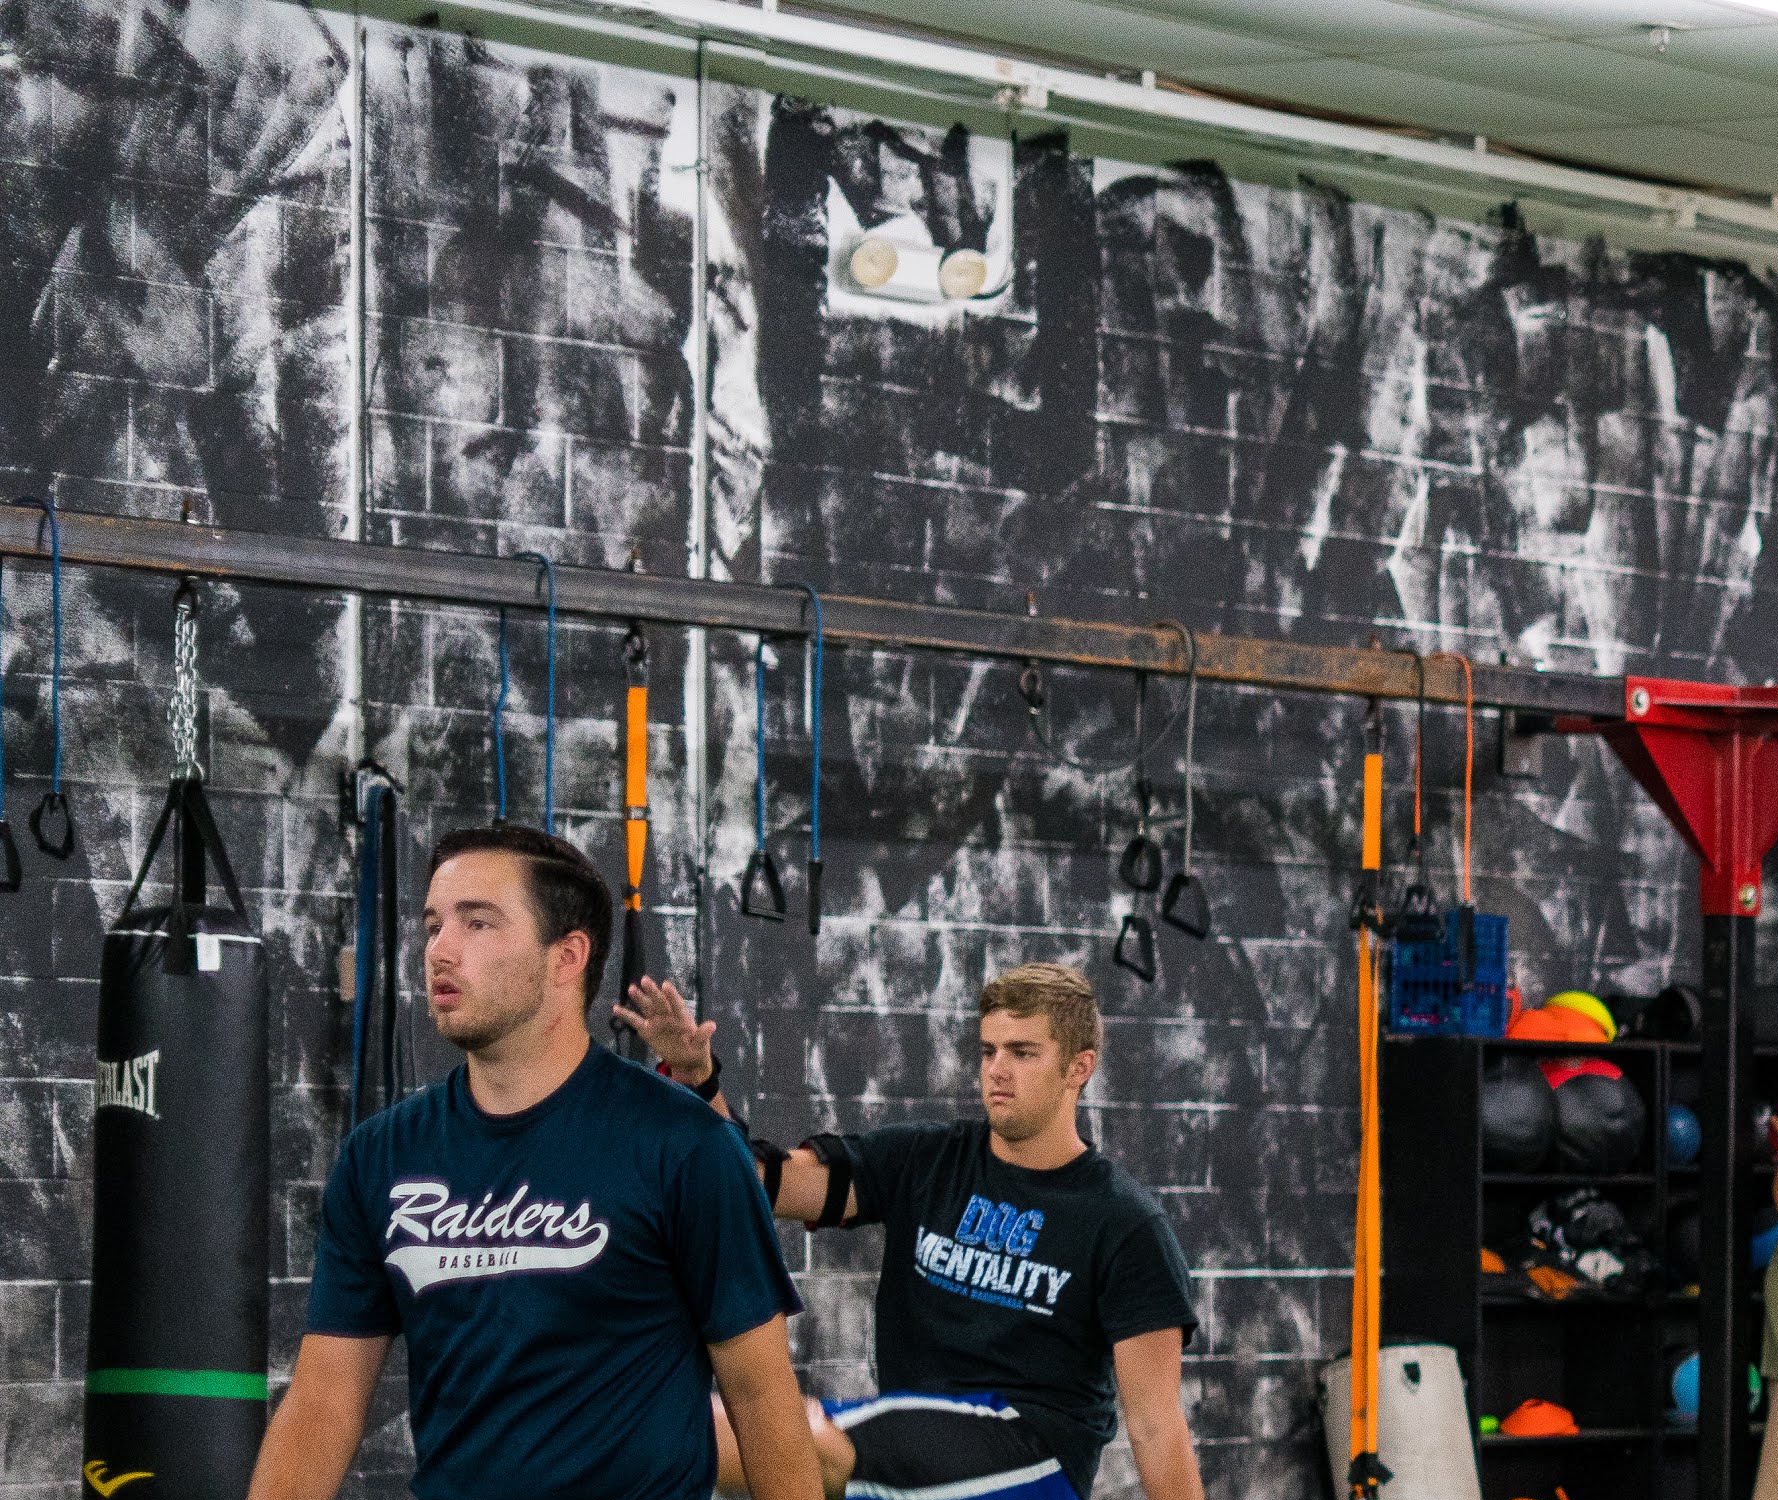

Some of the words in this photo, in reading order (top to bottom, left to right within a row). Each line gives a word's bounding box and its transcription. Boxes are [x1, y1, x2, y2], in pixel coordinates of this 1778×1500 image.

[386, 1183, 590, 1242] Raiders
[955, 1193, 1045, 1257] DOG
[915, 1225, 1072, 1304] MENTALITY
